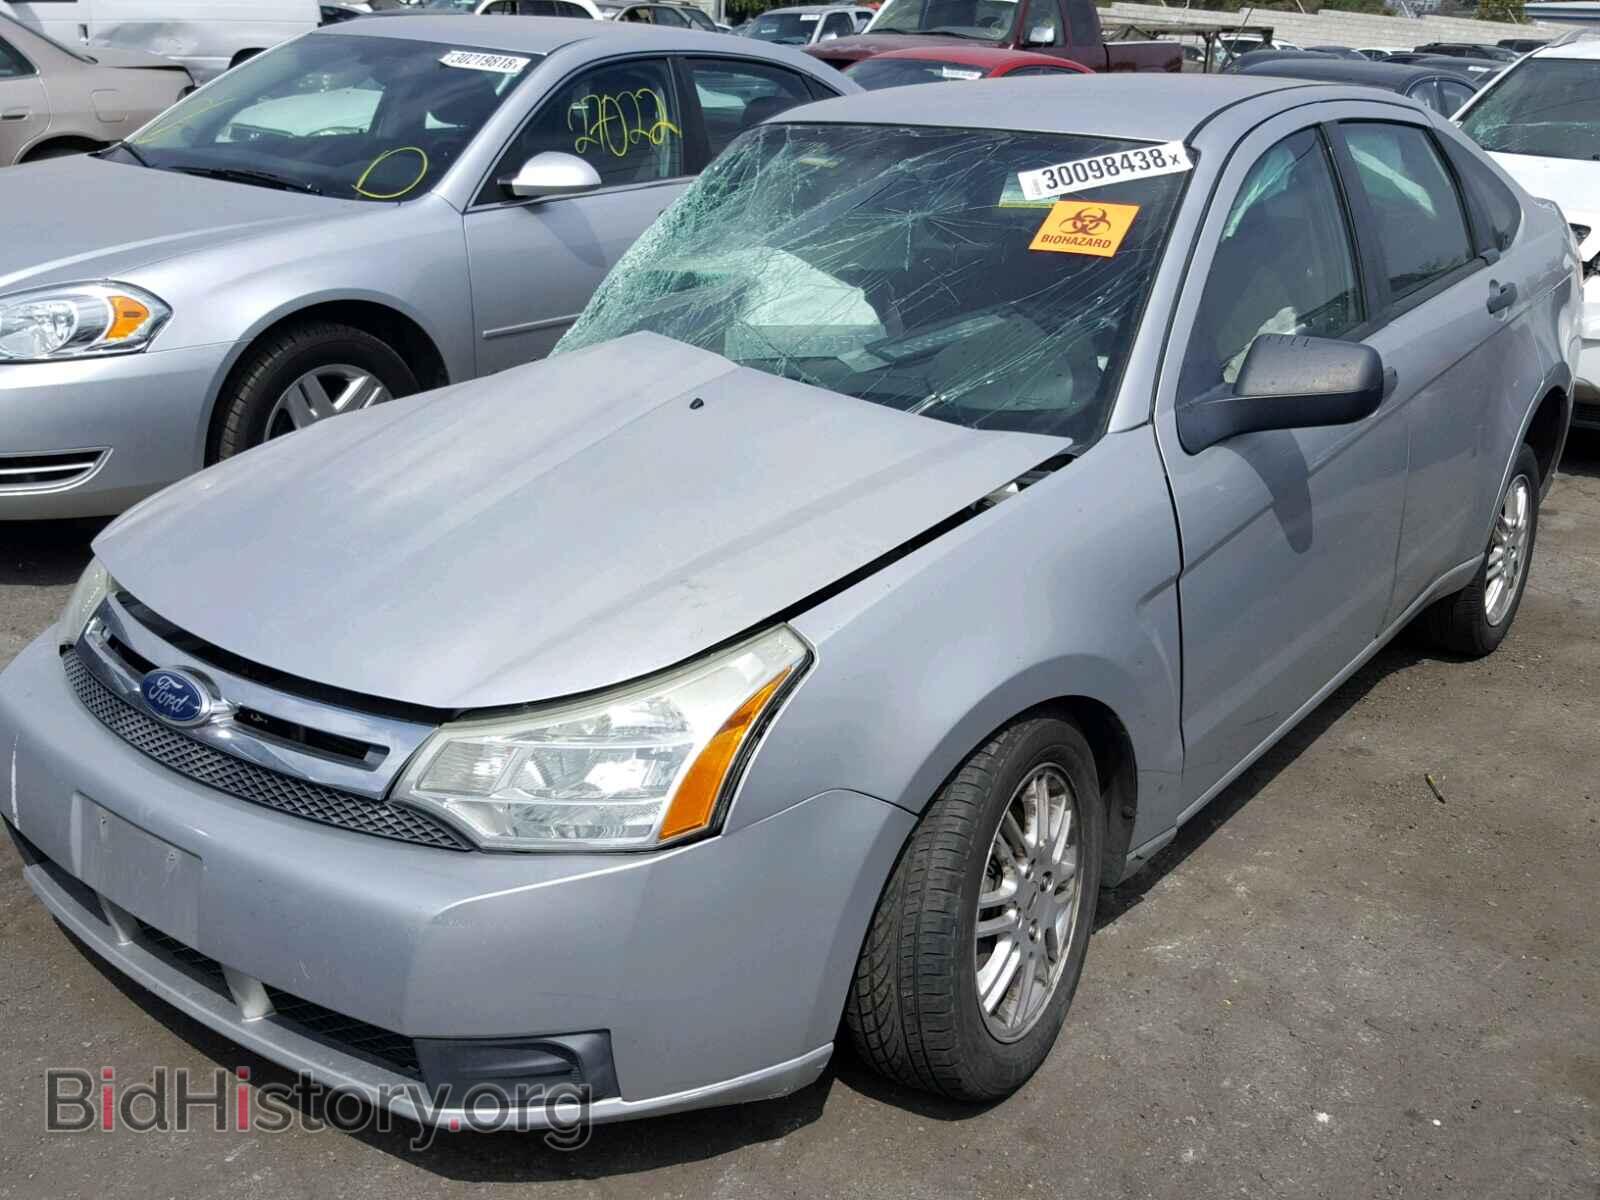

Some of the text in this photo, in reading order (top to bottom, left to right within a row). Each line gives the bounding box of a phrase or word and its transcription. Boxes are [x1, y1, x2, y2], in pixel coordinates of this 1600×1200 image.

[1042, 148, 1168, 190] 30098438
[1041, 233, 1112, 249] BIOHAZARD
[147, 675, 191, 713] Ford
